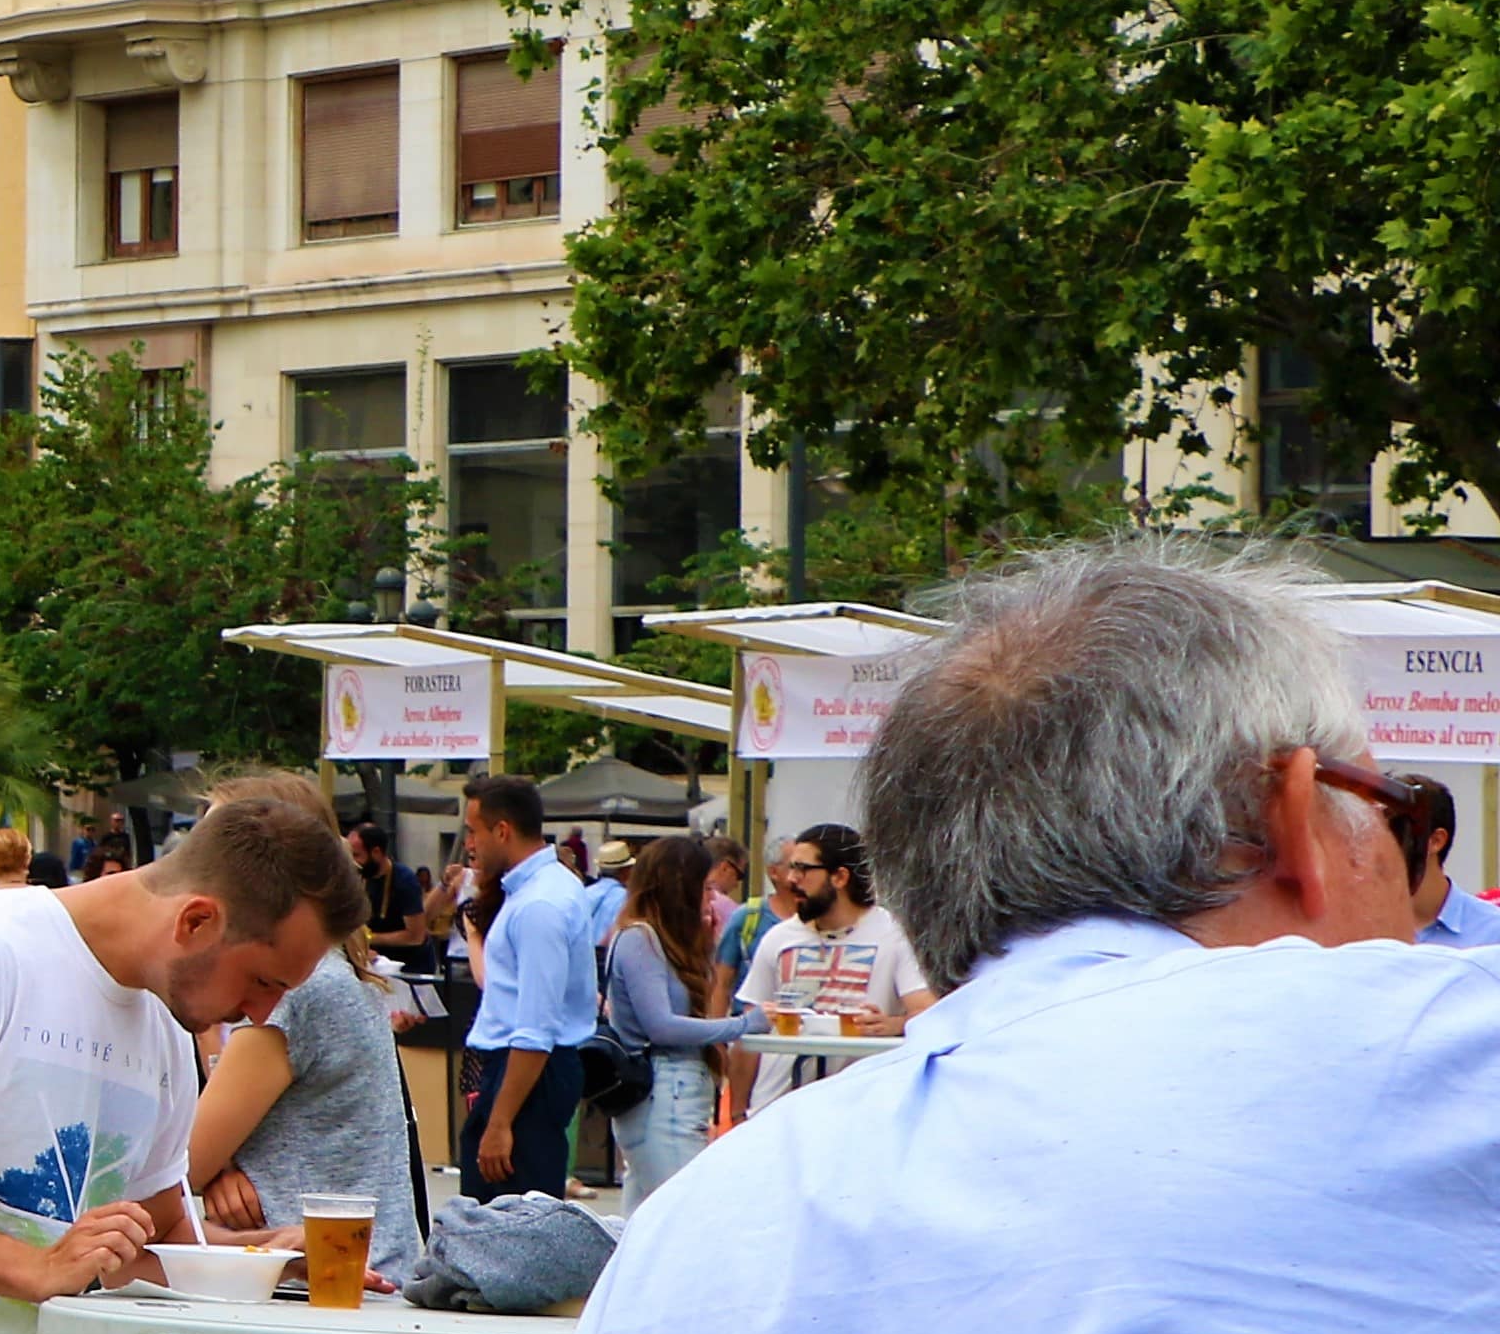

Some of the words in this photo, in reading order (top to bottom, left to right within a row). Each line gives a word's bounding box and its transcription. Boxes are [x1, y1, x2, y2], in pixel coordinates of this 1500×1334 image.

[1404, 649, 1484, 674] ESENCIA
[404, 674, 462, 693] FORASTERA
[1362, 689, 1405, 711] Arroz
[1407, 690, 1460, 712] Bomba
[1438, 722, 1453, 745] al
[1456, 729, 1496, 754] curry
[21, 1025, 114, 1063] TOUCHÉ
